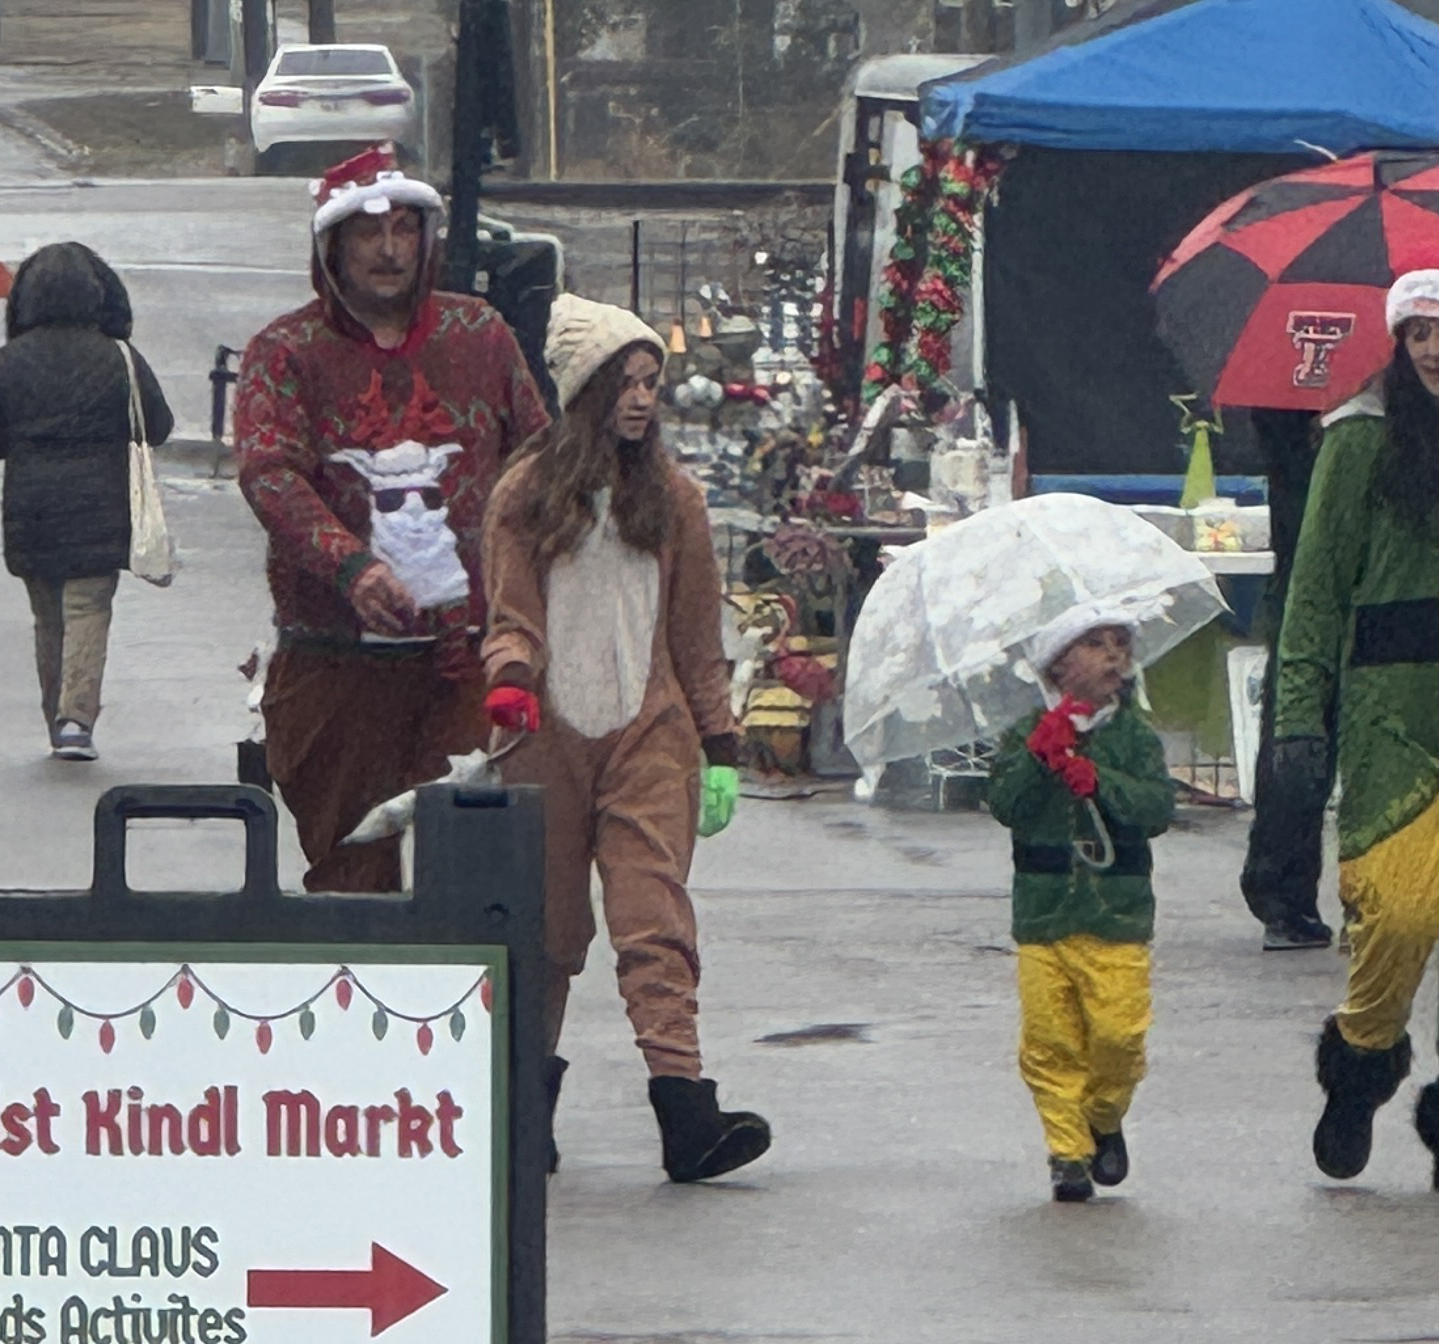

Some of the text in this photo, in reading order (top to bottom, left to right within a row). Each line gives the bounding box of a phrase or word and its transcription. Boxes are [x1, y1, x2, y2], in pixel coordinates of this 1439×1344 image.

[80, 1084, 242, 1158] Kindl
[261, 1086, 465, 1159] Markt
[79, 1224, 221, 1279] CLAUS
